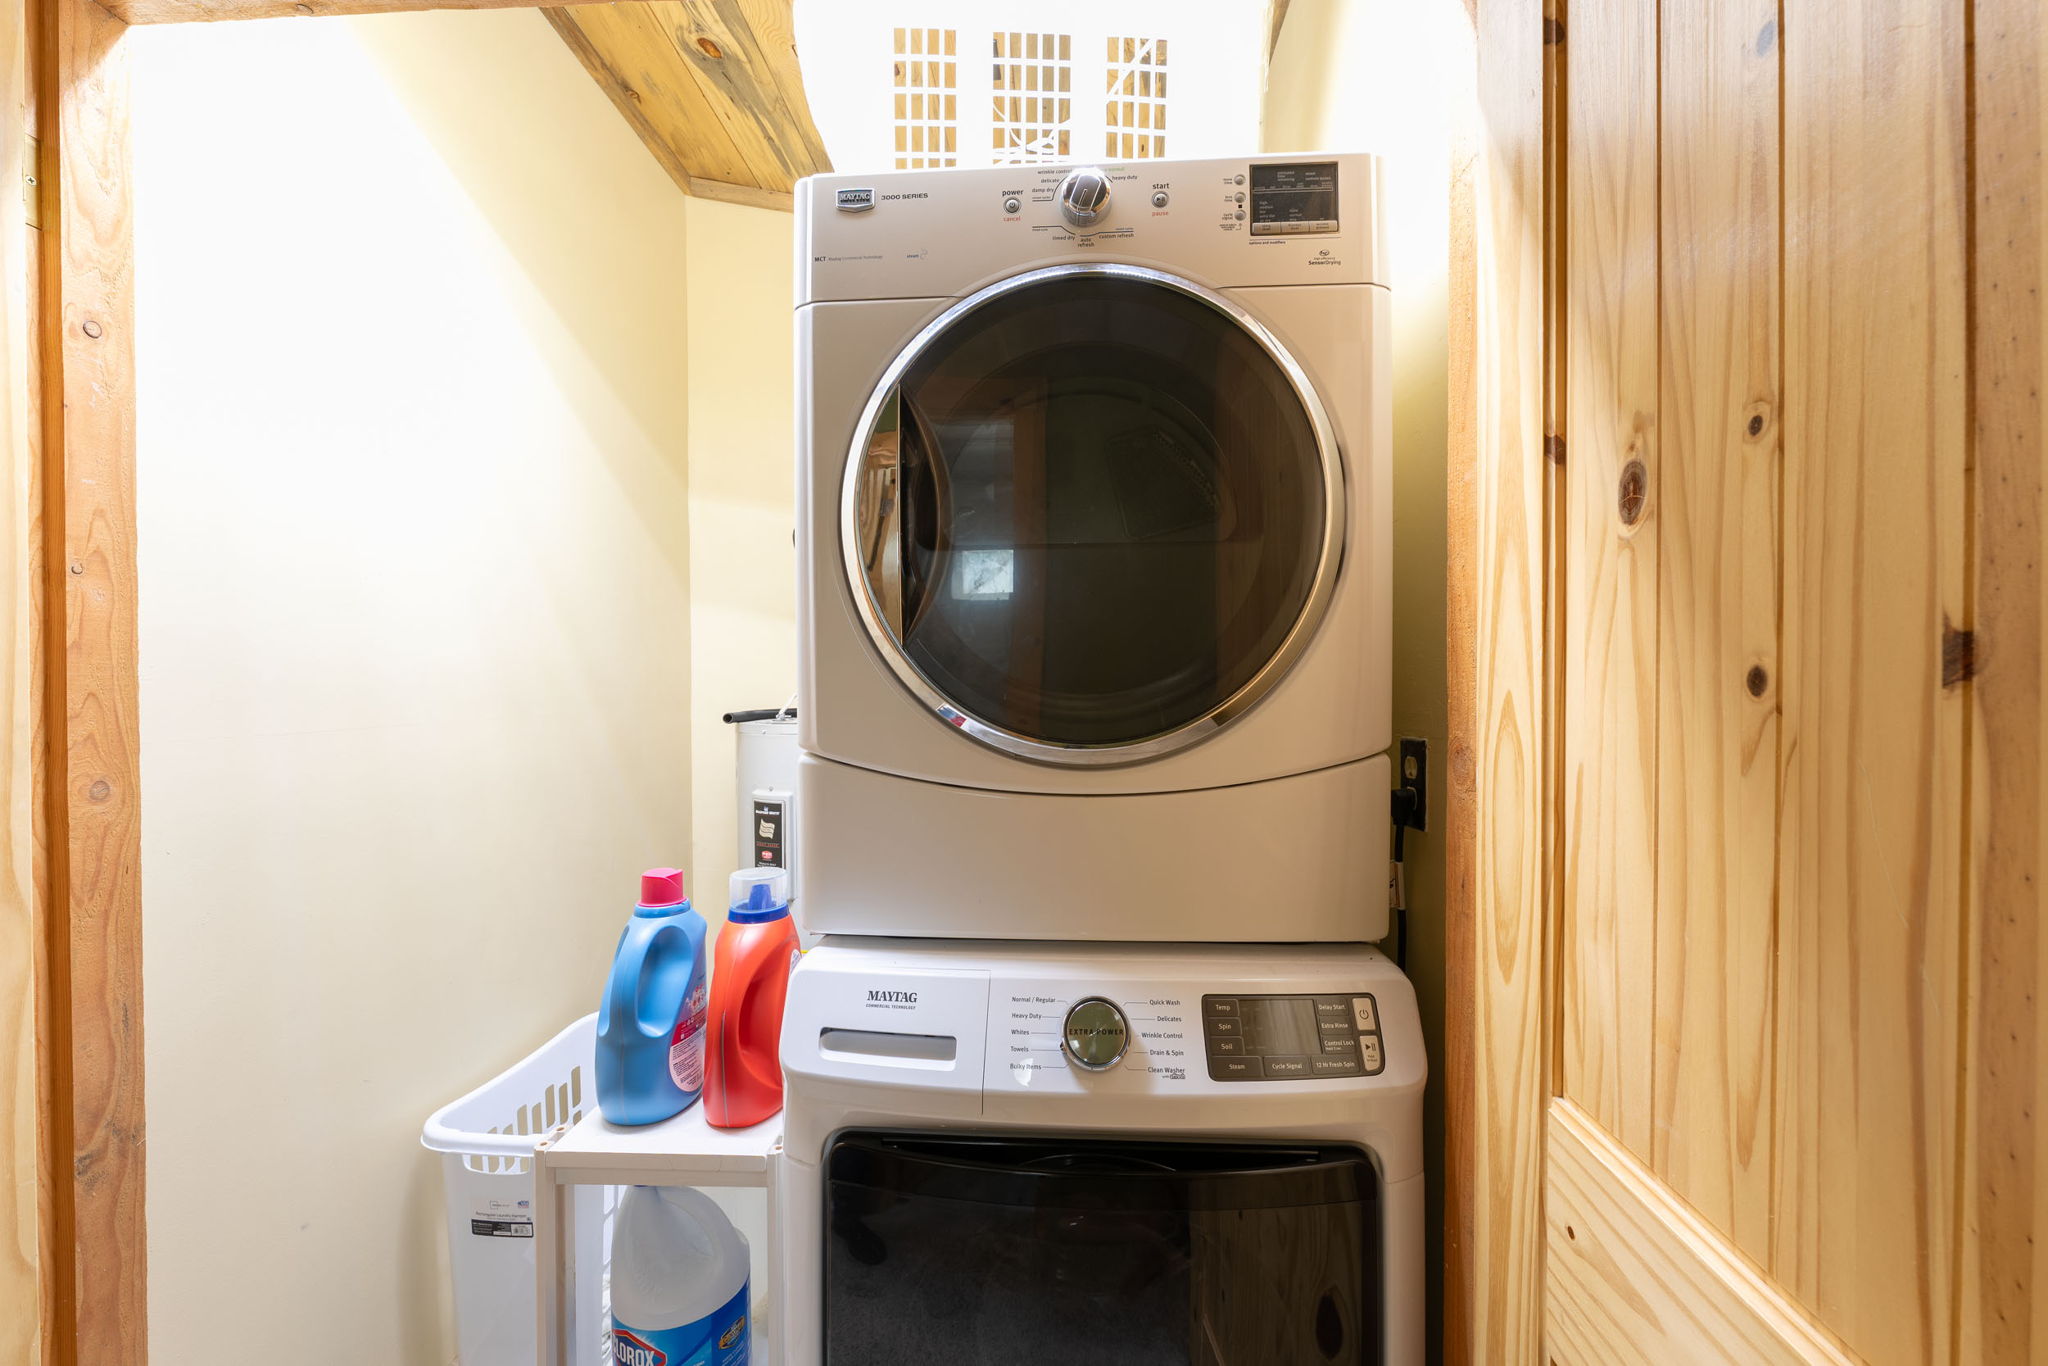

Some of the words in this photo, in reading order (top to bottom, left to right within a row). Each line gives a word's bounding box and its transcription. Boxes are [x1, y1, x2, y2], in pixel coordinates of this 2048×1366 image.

[1152, 182, 1170, 190] start
[840, 192, 871, 200] MAYTAG
[902, 192, 929, 200] SERIES
[1002, 189, 1024, 197] power
[867, 990, 918, 1004] MAYTAG
[1215, 1004, 1231, 1012] Temp
[1218, 1023, 1232, 1031] Spin
[1068, 1028, 1093, 1036] EXTRA
[1096, 1028, 1124, 1036] POWER
[1010, 1045, 1029, 1053] Towels
[1171, 1049, 1184, 1057] Spin
[1009, 1062, 1026, 1071] Bulky
[1271, 1062, 1286, 1070] Cycle
[1286, 1062, 1303, 1070] Signal
